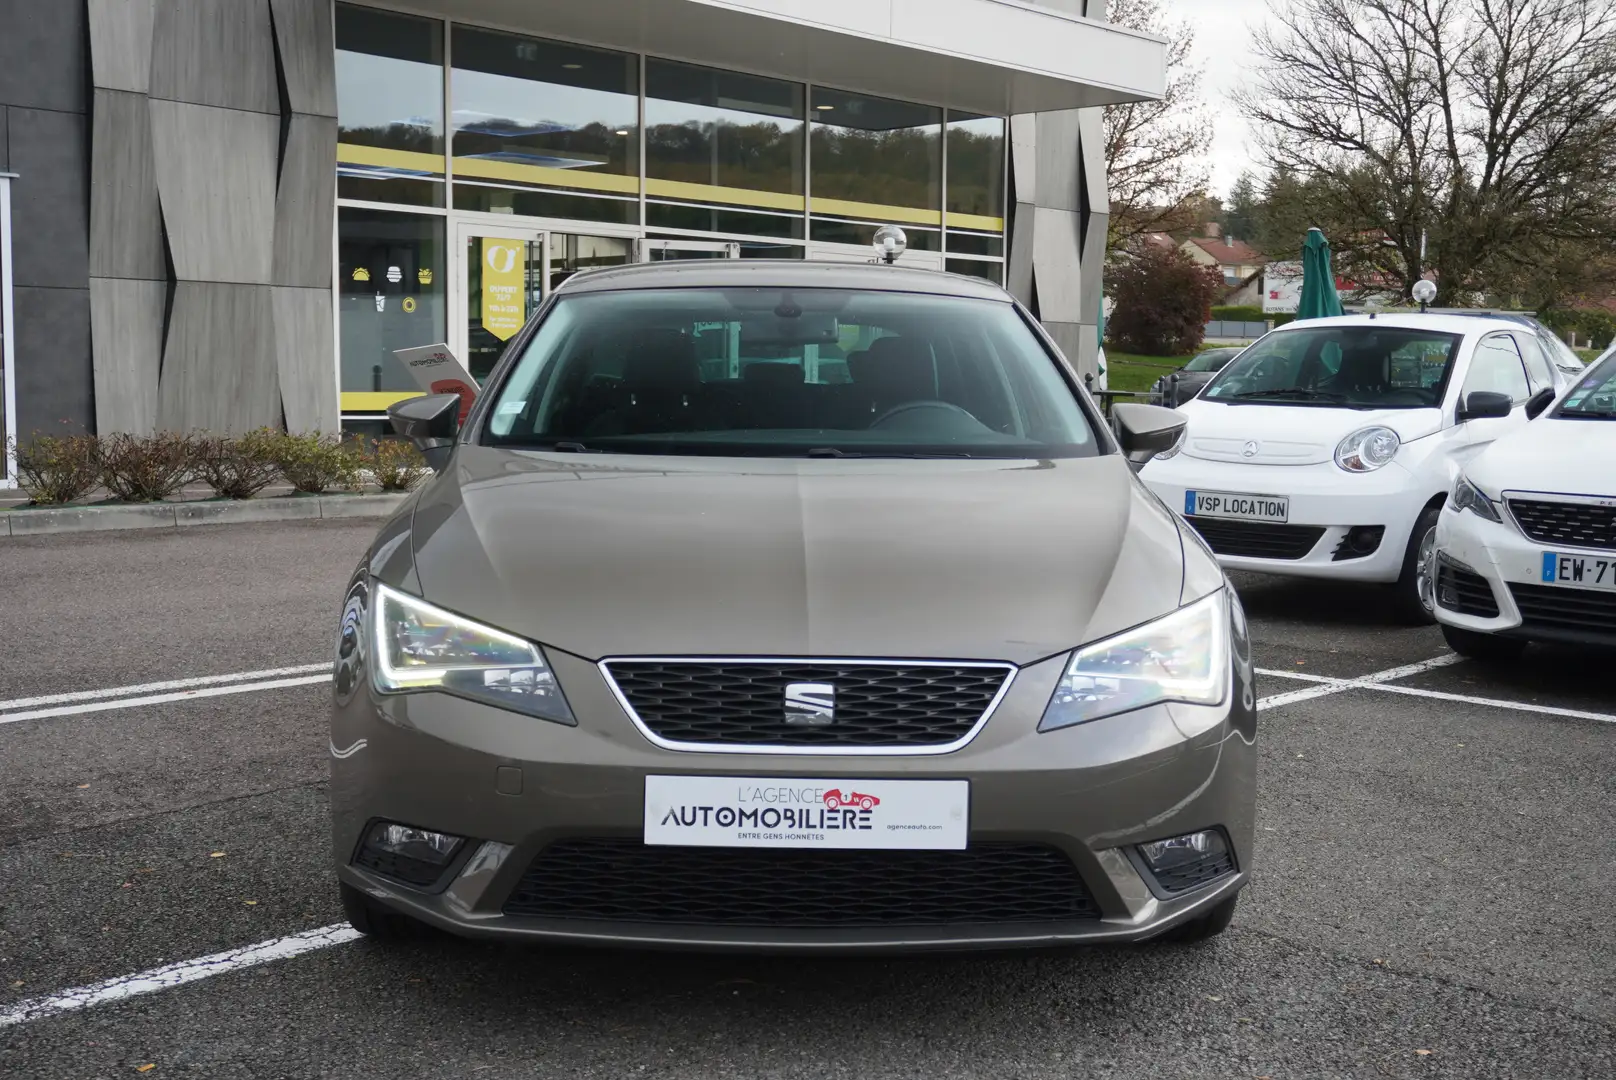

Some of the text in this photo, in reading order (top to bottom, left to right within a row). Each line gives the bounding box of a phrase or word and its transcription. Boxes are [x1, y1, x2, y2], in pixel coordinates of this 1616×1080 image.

[1197, 496, 1286, 517] VSP LOCATION
[738, 787, 824, 804] L'AGENCE
